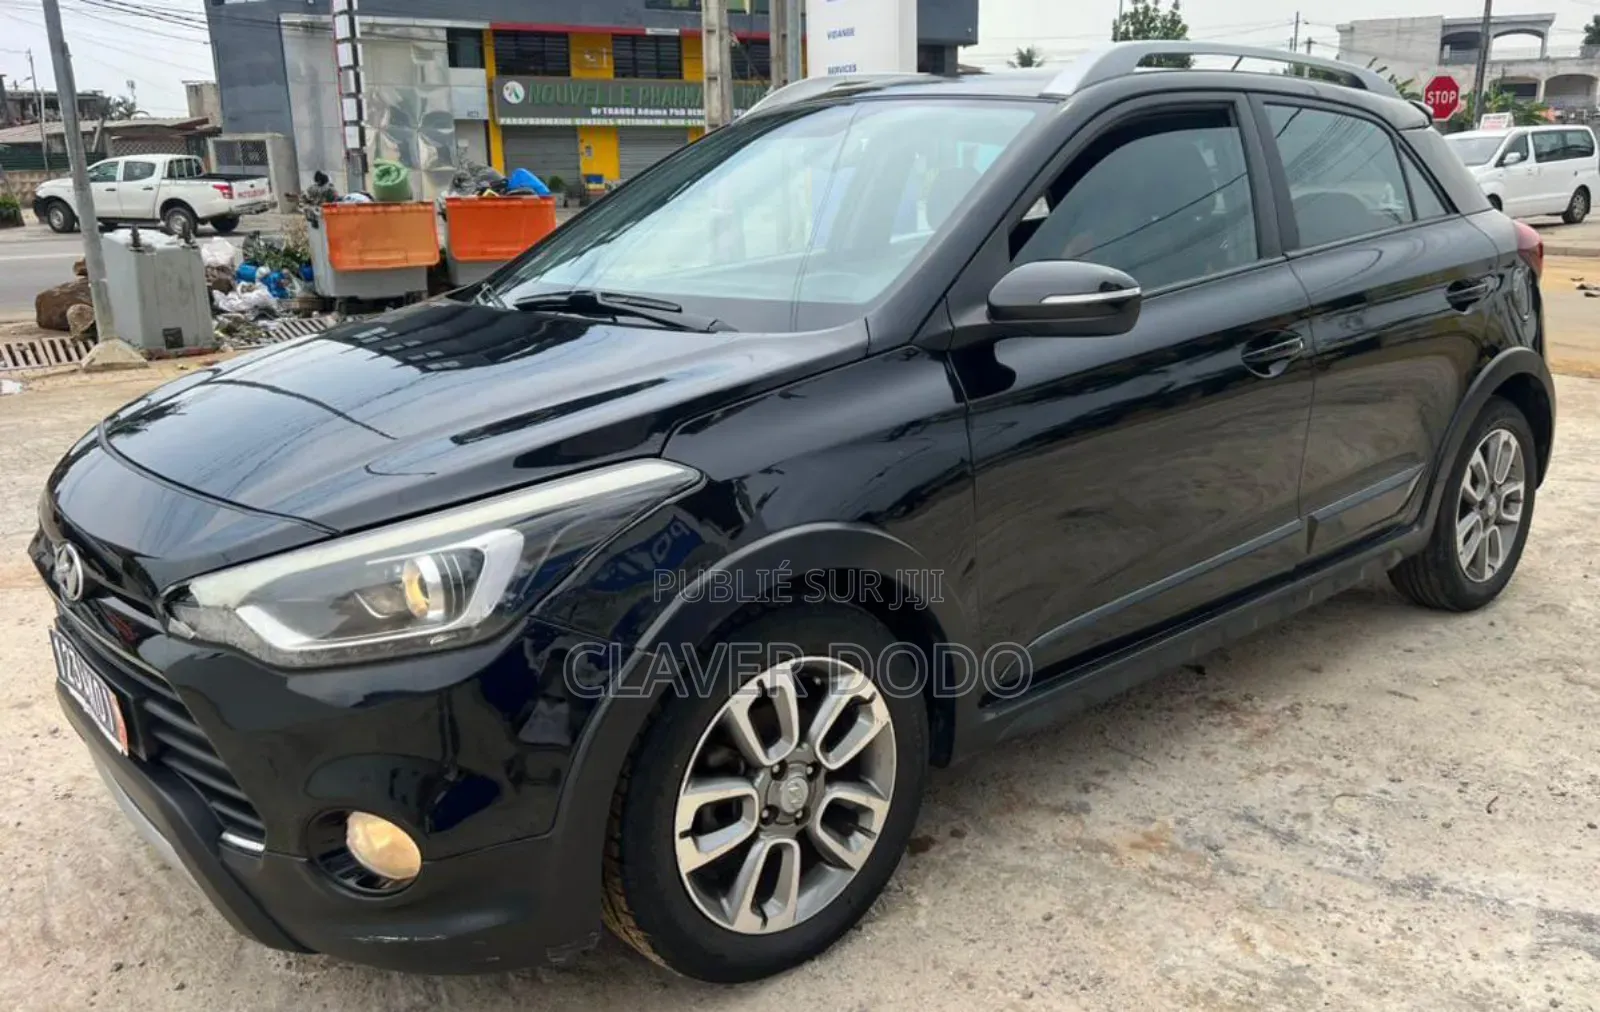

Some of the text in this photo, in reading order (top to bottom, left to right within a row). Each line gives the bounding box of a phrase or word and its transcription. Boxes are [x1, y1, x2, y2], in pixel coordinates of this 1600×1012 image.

[828, 64, 857, 75] SERVICES
[529, 83, 705, 107] NOUVELLE PHARMA
[1427, 90, 1457, 105] STOP
